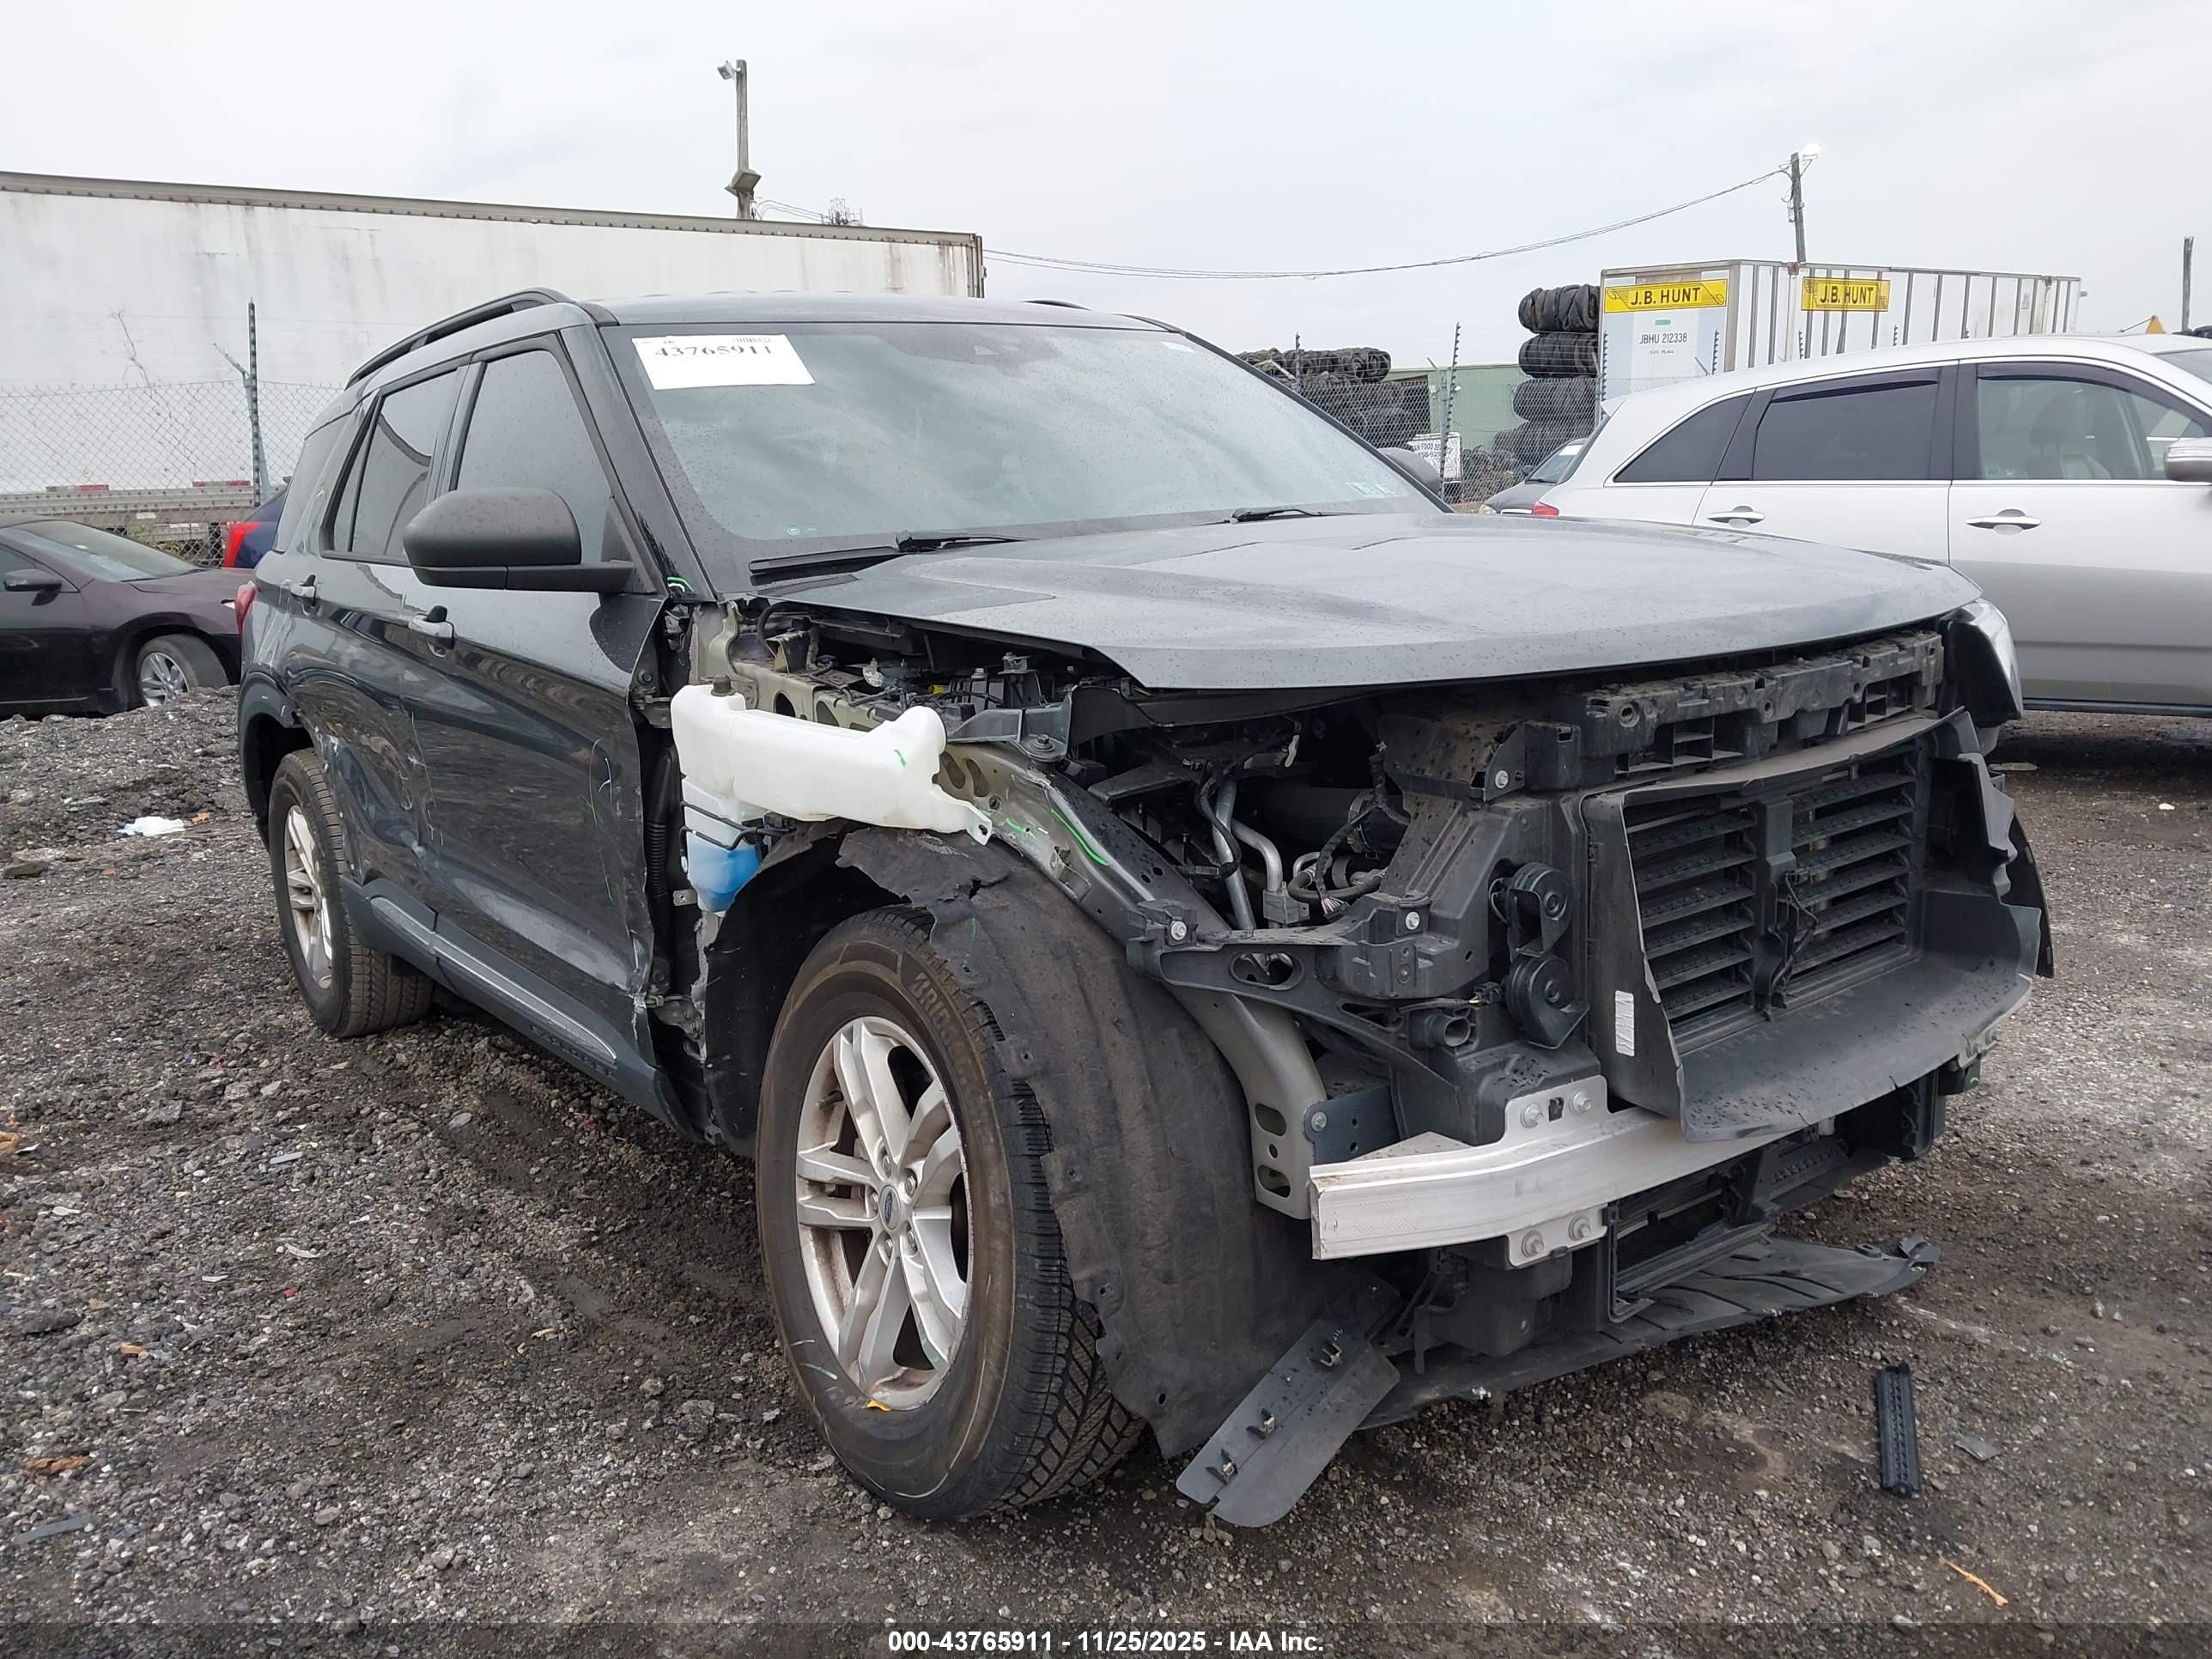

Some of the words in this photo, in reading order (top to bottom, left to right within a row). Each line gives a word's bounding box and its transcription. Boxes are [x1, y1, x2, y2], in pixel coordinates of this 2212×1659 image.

[1631, 290, 1656, 306] J.B.
[1660, 287, 1701, 304] HUNT
[1820, 285, 1841, 304] J.B.
[1844, 286, 1874, 304] HUNT
[1638, 333, 1660, 344] JBHU
[1662, 332, 1688, 343] 212338
[655, 345, 772, 356] 43765911
